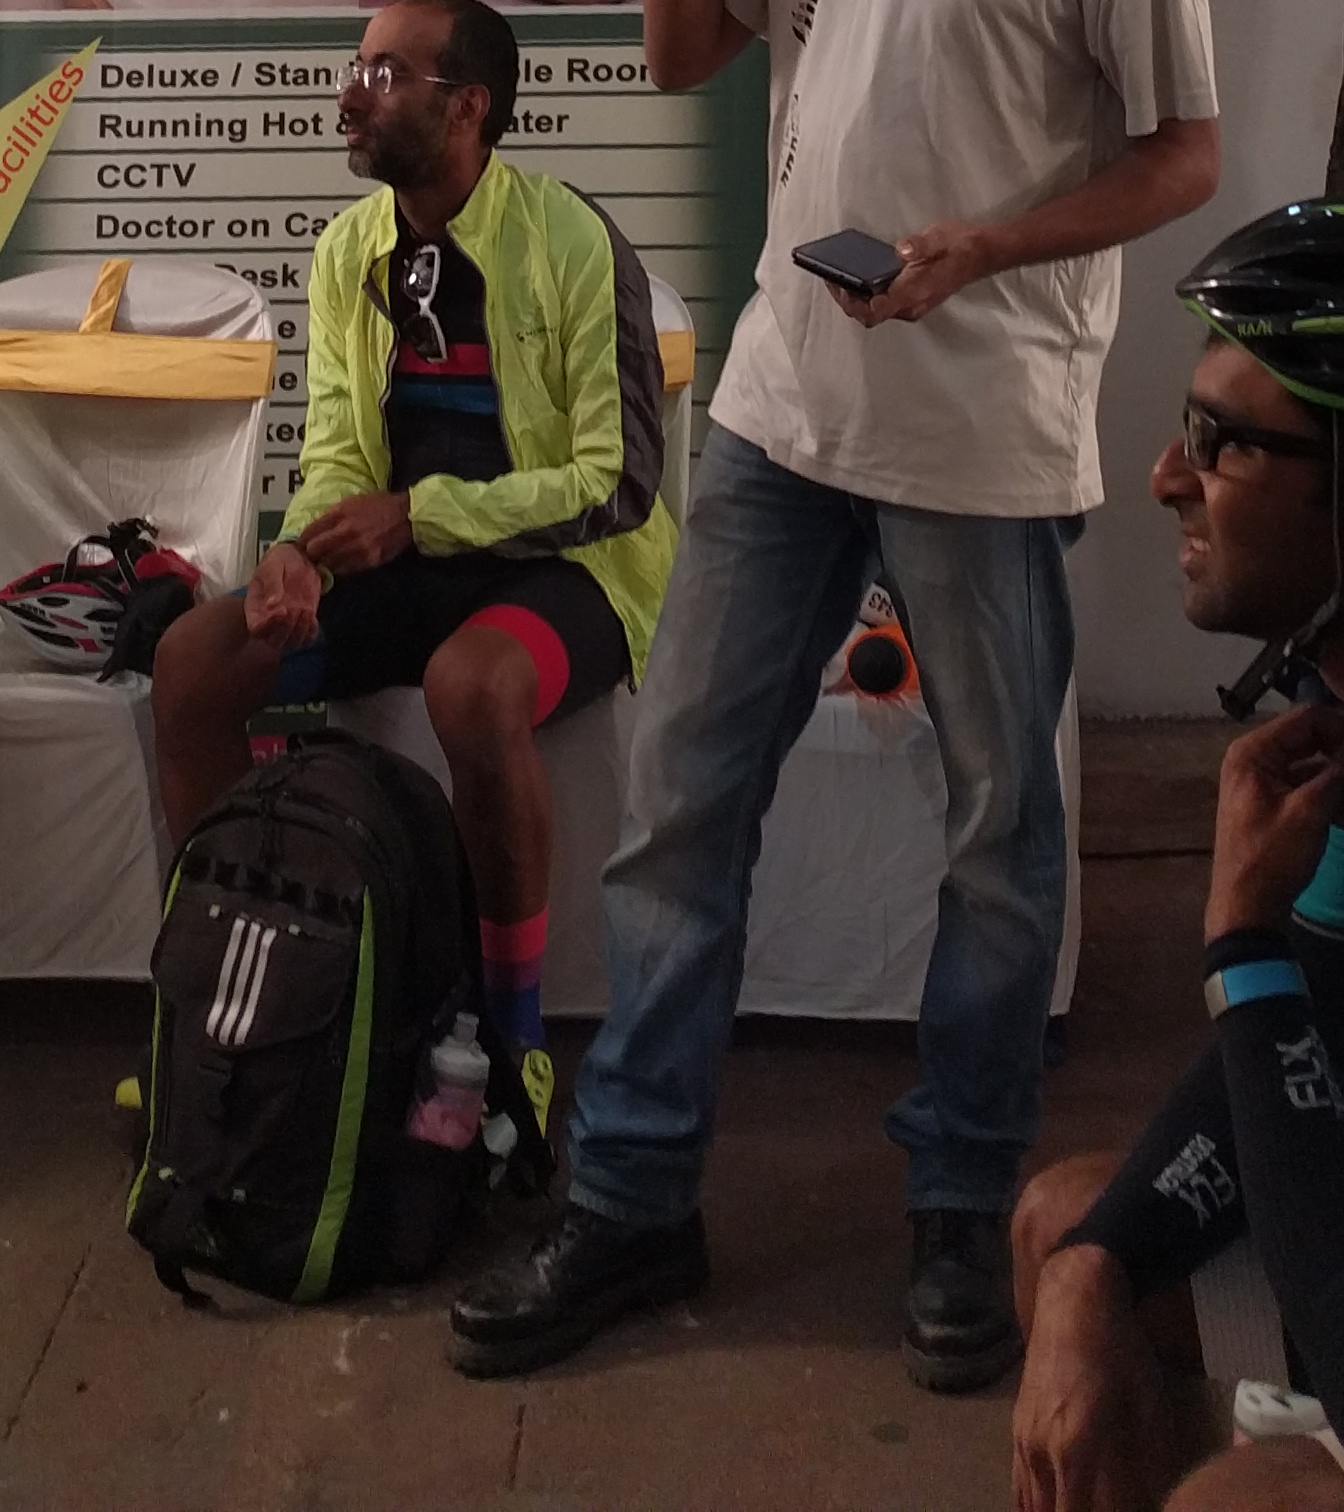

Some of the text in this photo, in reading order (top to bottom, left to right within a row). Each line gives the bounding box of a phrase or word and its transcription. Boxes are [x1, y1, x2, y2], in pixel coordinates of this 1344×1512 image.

[100, 63, 219, 88] Deluxe
[231, 62, 242, 87] /
[98, 112, 248, 143] Running
[262, 111, 324, 137] Hot
[506, 108, 570, 133] ater
[96, 162, 197, 189] CCTV
[95, 213, 216, 239] Doctor
[227, 217, 271, 238] on
